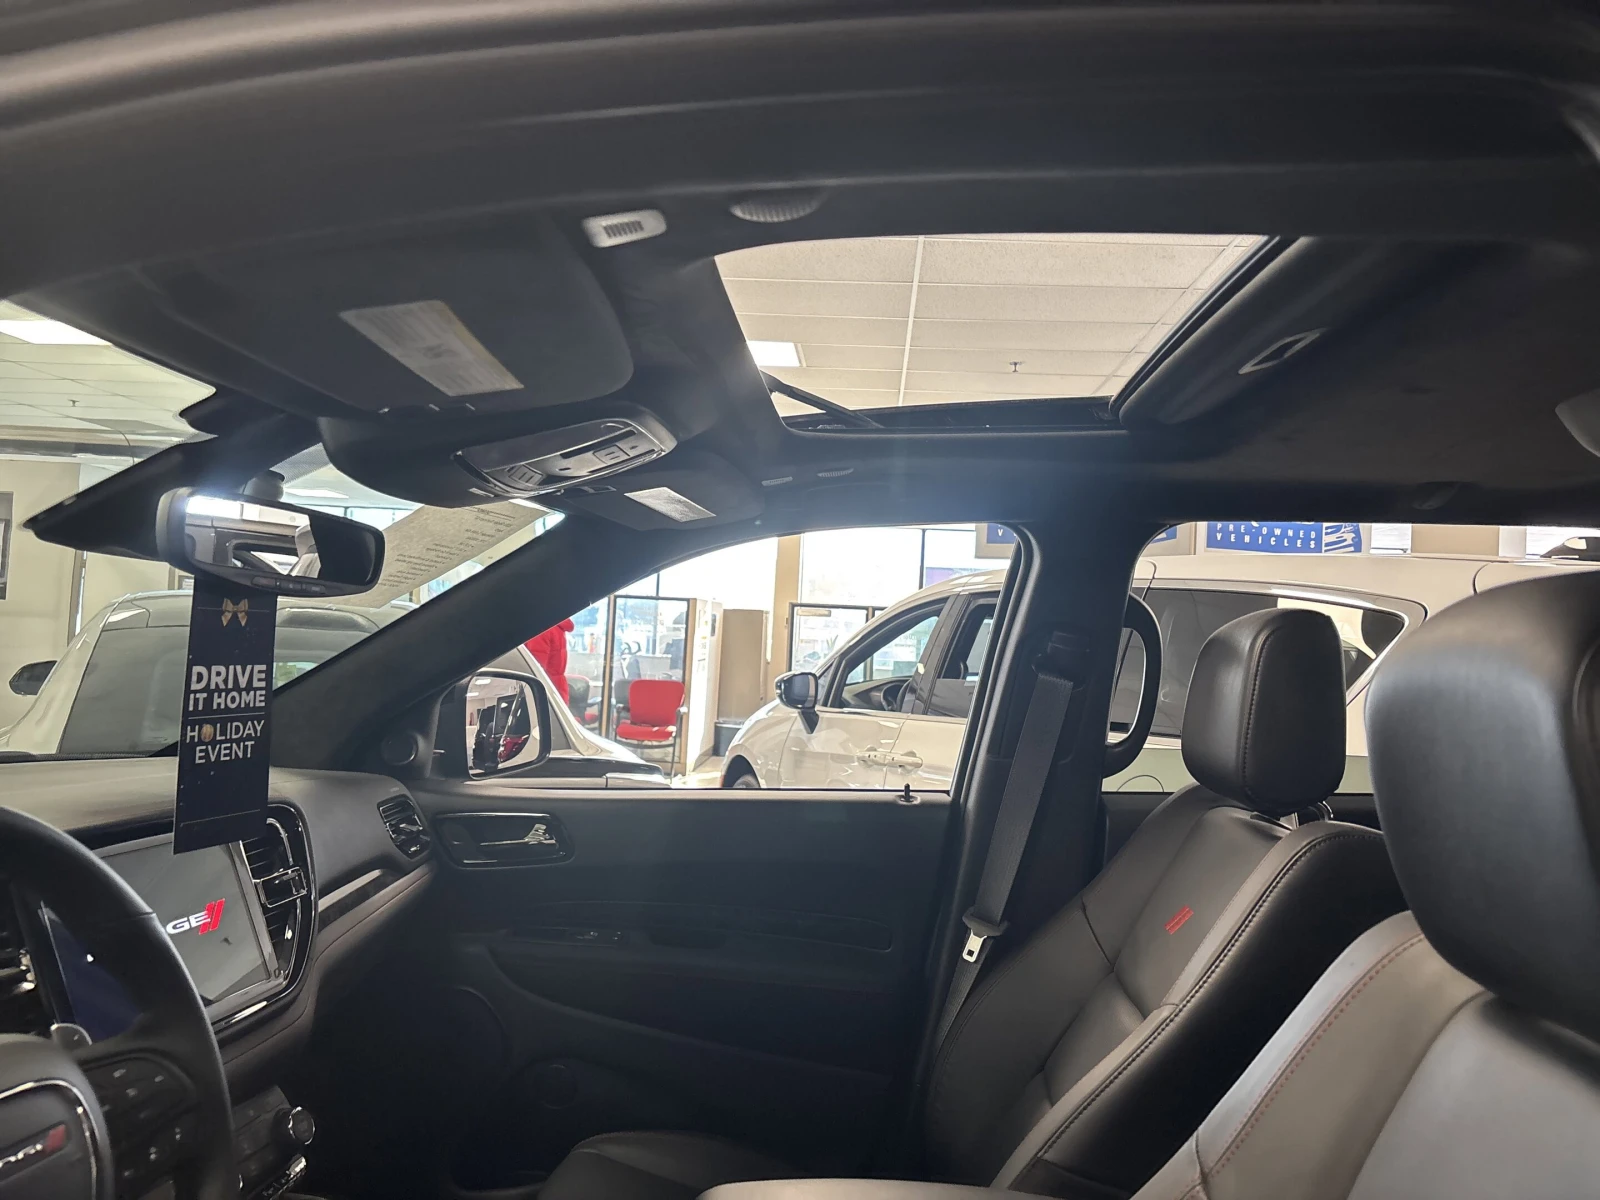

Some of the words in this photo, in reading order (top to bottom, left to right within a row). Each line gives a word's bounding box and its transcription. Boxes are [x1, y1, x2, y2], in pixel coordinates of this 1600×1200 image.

[1216, 522, 1316, 539] PRE-OWNED
[1216, 532, 1316, 549] VEHICLES
[190, 664, 267, 691] DRIVE
[188, 692, 208, 712] IT
[212, 690, 266, 710] HOME
[186, 719, 265, 744] HOLIDAY
[195, 740, 255, 764] EVENT
